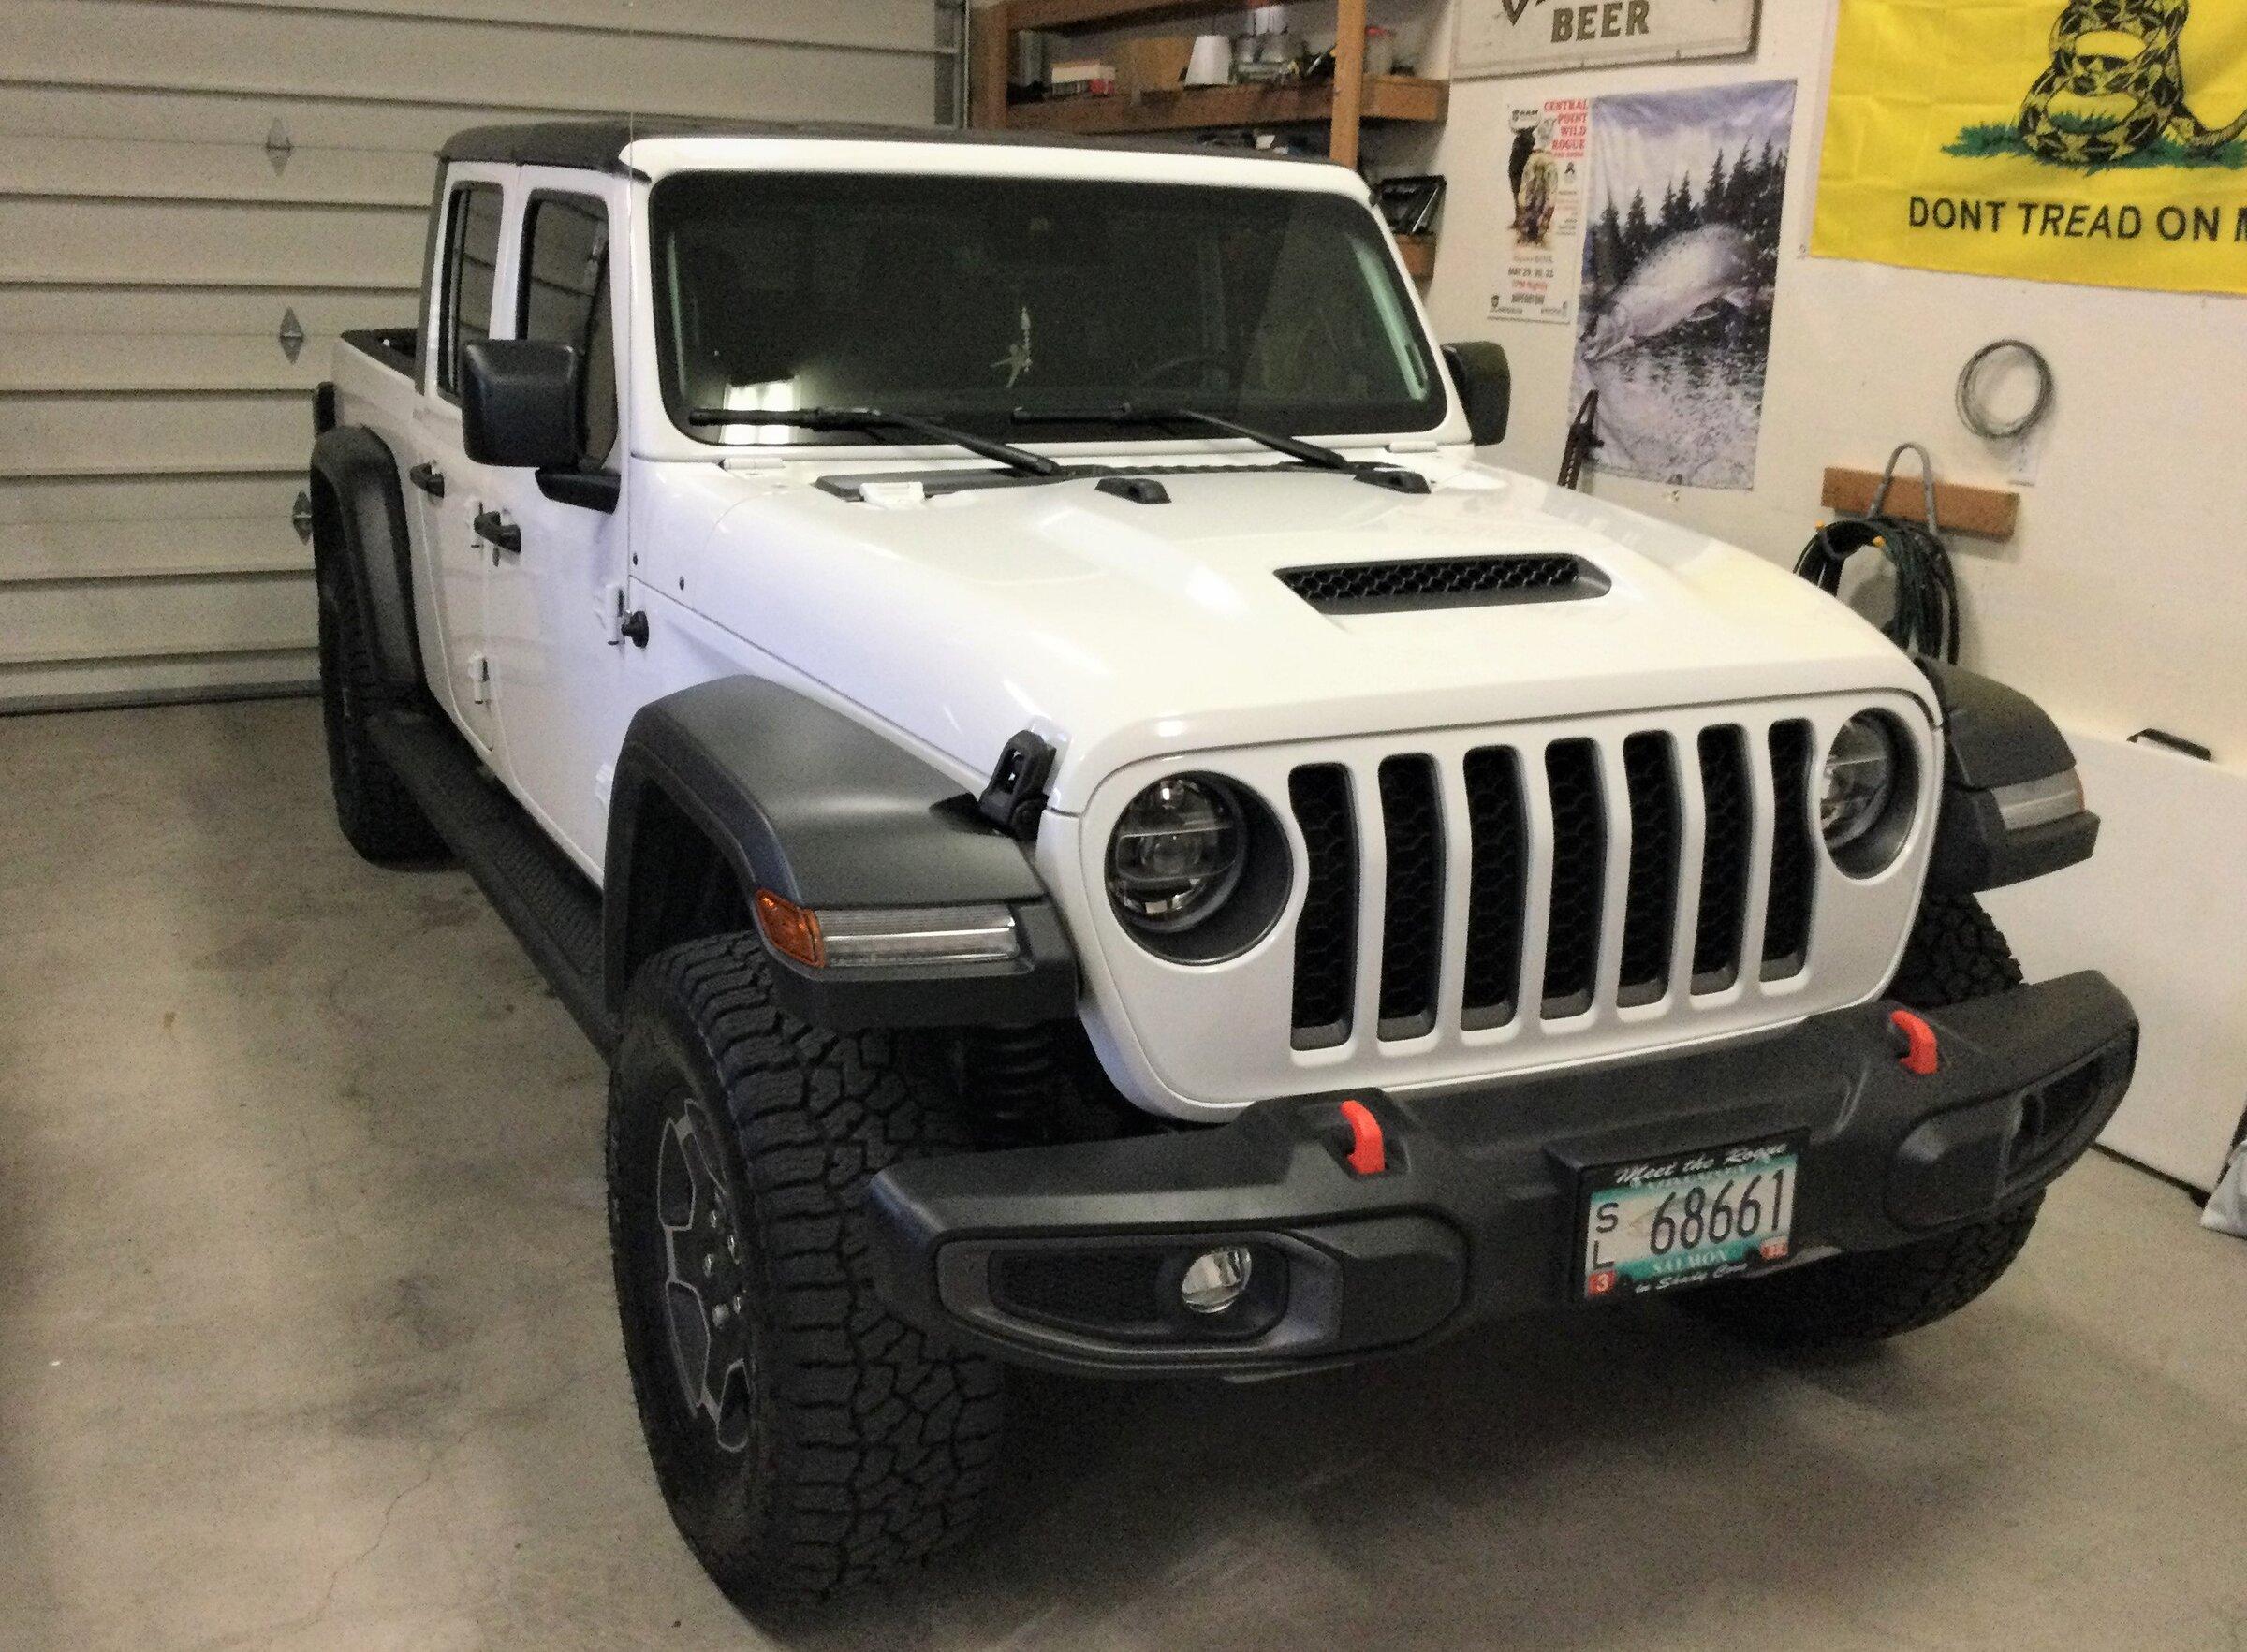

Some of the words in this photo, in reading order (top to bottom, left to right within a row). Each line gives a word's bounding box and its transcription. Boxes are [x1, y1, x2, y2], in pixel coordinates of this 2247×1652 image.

[1550, 1, 1650, 43] BEER
[1544, 100, 1587, 111] CENTRAL
[1558, 112, 1587, 124] POINT
[1551, 139, 1585, 150] ROGUE
[1561, 125, 1587, 136] WILD
[1909, 196, 2005, 232] DONT
[2018, 203, 2141, 240] TREAD
[2157, 205, 2219, 241] ON
[1595, 1202, 1619, 1234] S
[1649, 1168, 1784, 1256] 68661
[1593, 1240, 1615, 1269] L
